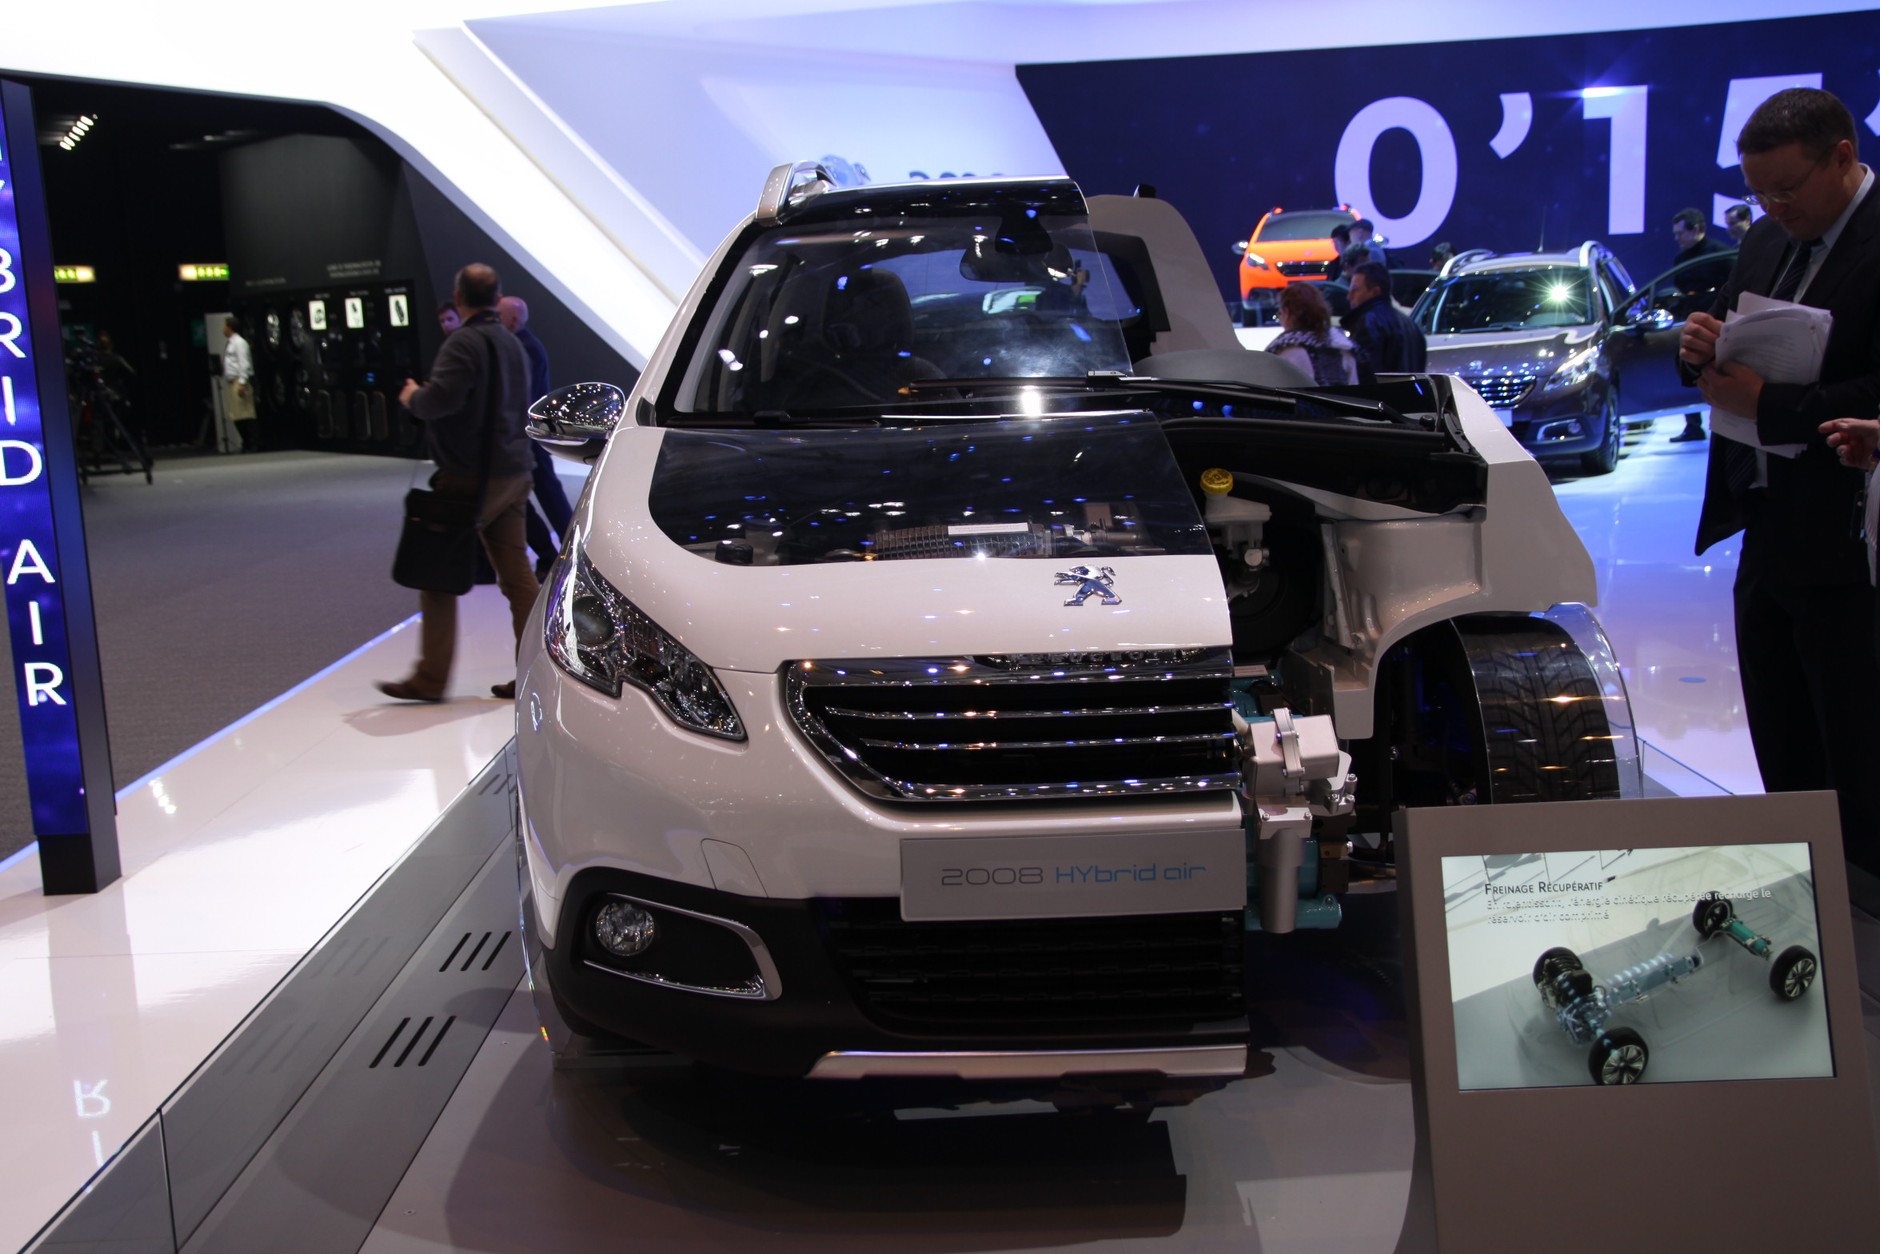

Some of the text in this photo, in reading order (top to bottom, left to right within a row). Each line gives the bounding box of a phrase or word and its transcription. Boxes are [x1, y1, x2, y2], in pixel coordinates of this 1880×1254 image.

[7, 538, 68, 707] AIR
[941, 862, 1207, 886] 2008 HYbrid air
[1484, 883, 1534, 895] FREINAGE
